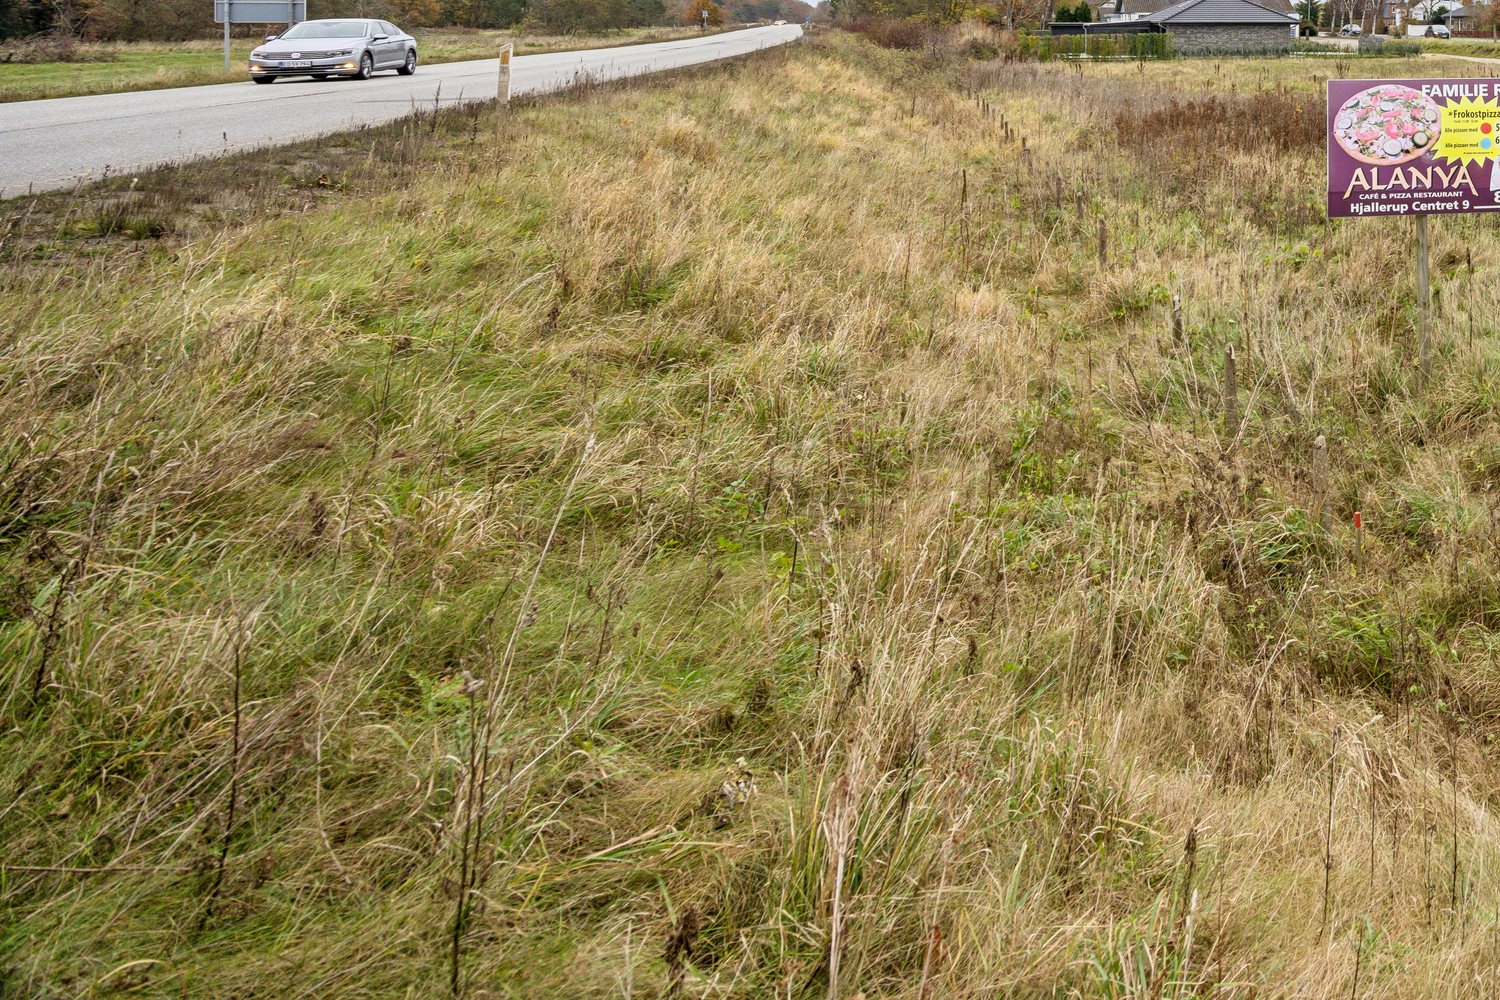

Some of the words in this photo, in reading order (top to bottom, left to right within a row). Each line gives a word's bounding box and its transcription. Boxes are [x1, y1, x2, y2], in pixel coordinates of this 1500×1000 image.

[1421, 84, 1488, 98] FAMILIE
[1343, 166, 1479, 199] ALANYA
[1350, 202, 1408, 213] Hjallerup
[1412, 201, 1459, 212] Centret
[1462, 200, 1470, 209] 9
